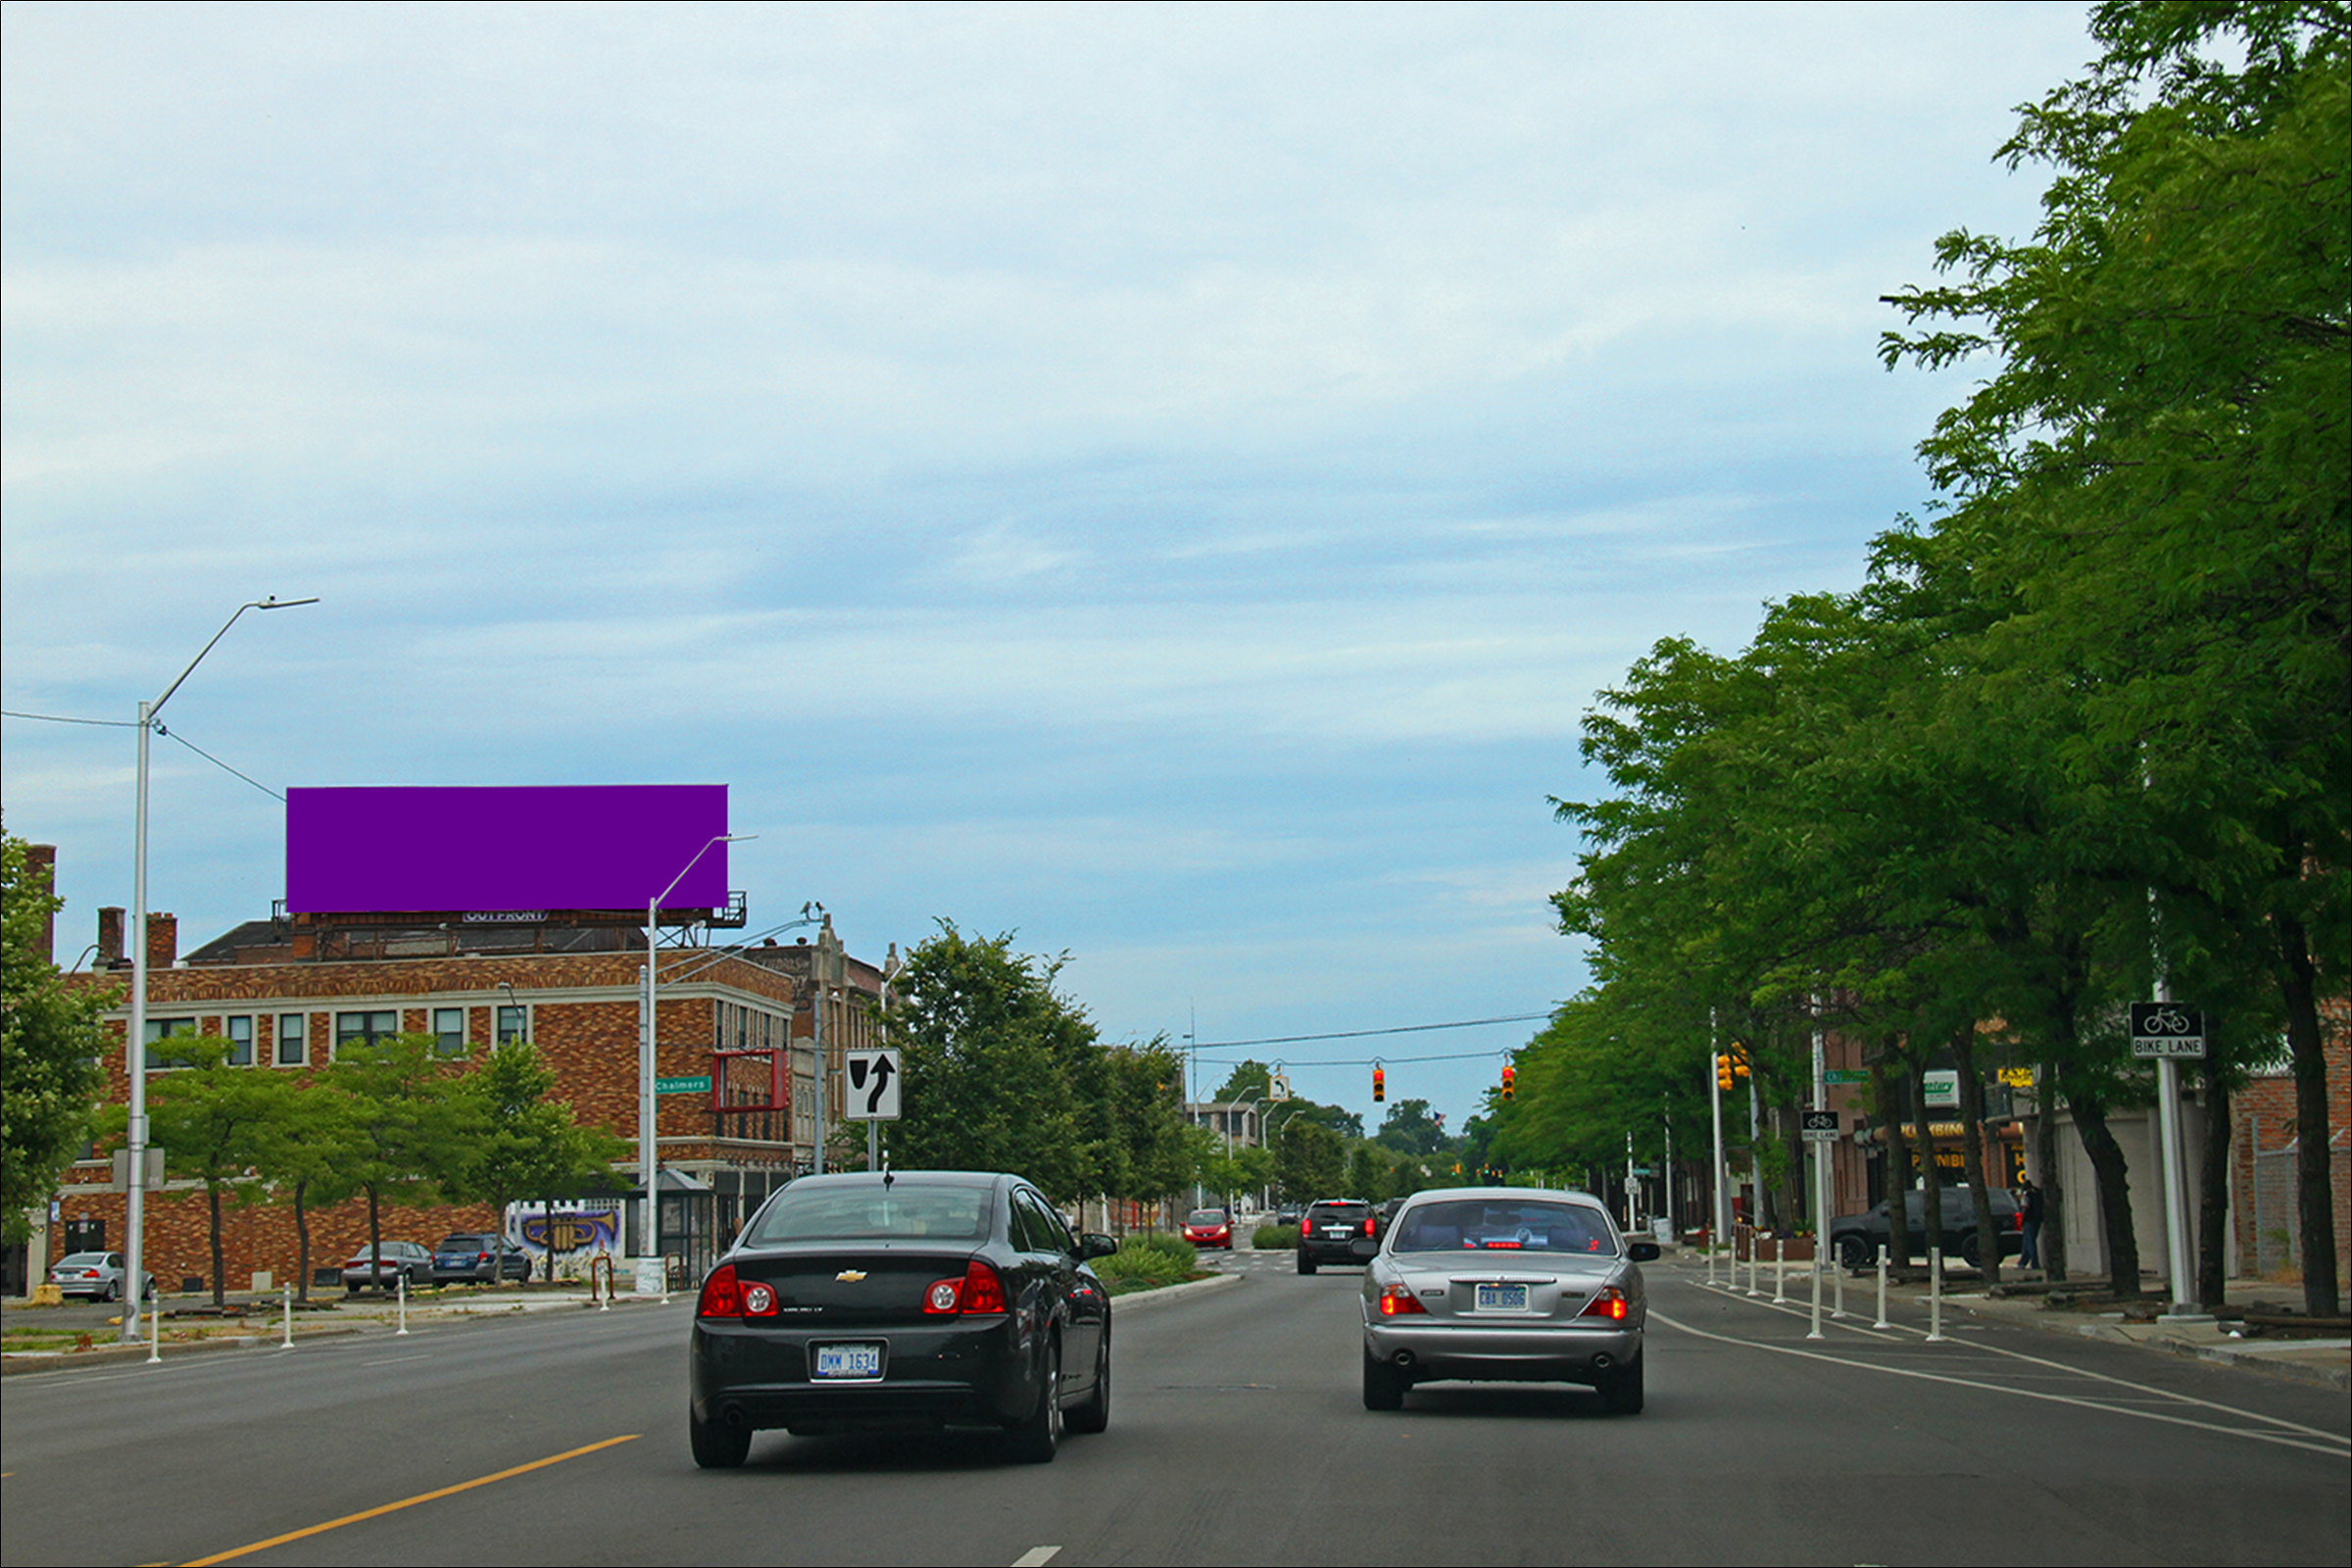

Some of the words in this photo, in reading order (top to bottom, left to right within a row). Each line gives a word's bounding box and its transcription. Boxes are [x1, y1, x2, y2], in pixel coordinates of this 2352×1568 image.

[2134, 1040, 2163, 1054] BIKE
[2168, 1040, 2201, 1054] LANE
[655, 1081, 705, 1092] Chalmers
[849, 1353, 876, 1370] 1634
